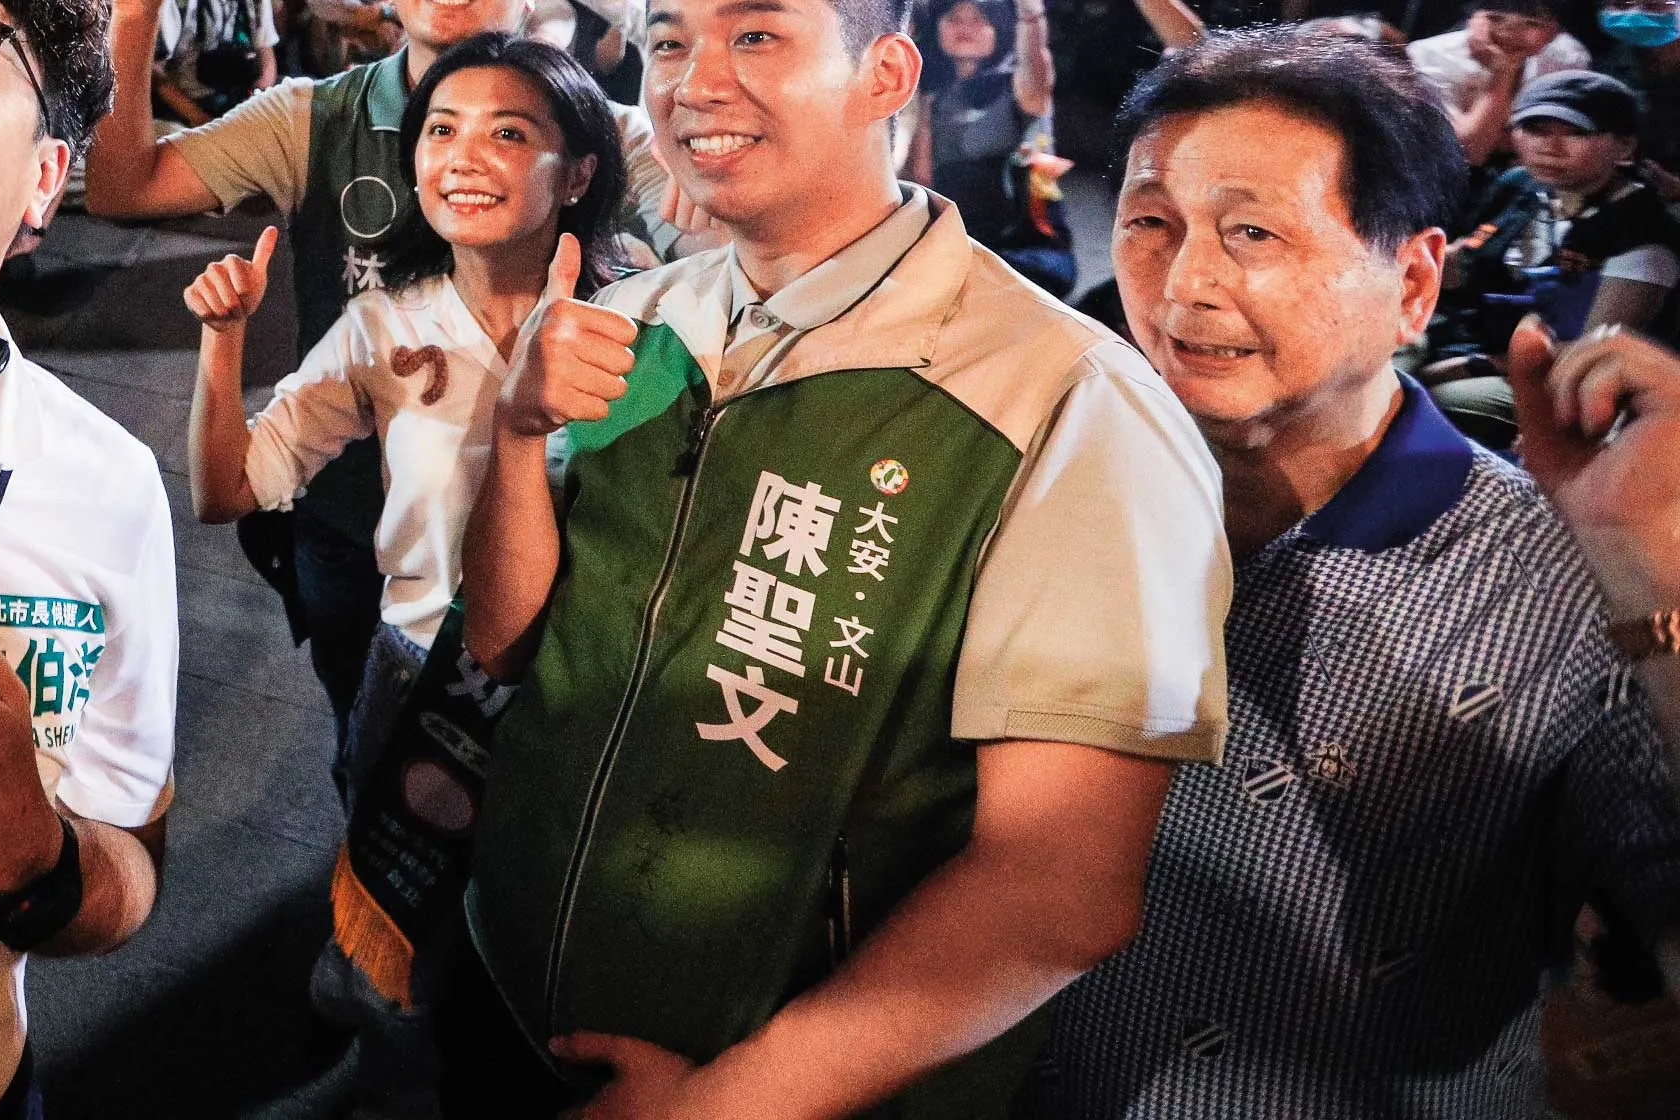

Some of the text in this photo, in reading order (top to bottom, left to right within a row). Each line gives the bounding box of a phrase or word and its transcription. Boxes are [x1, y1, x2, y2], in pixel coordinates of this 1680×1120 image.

[342, 245, 386, 295] 林
[695, 470, 841, 773] 陳聖文
[44, 723, 77, 748] SHEN
